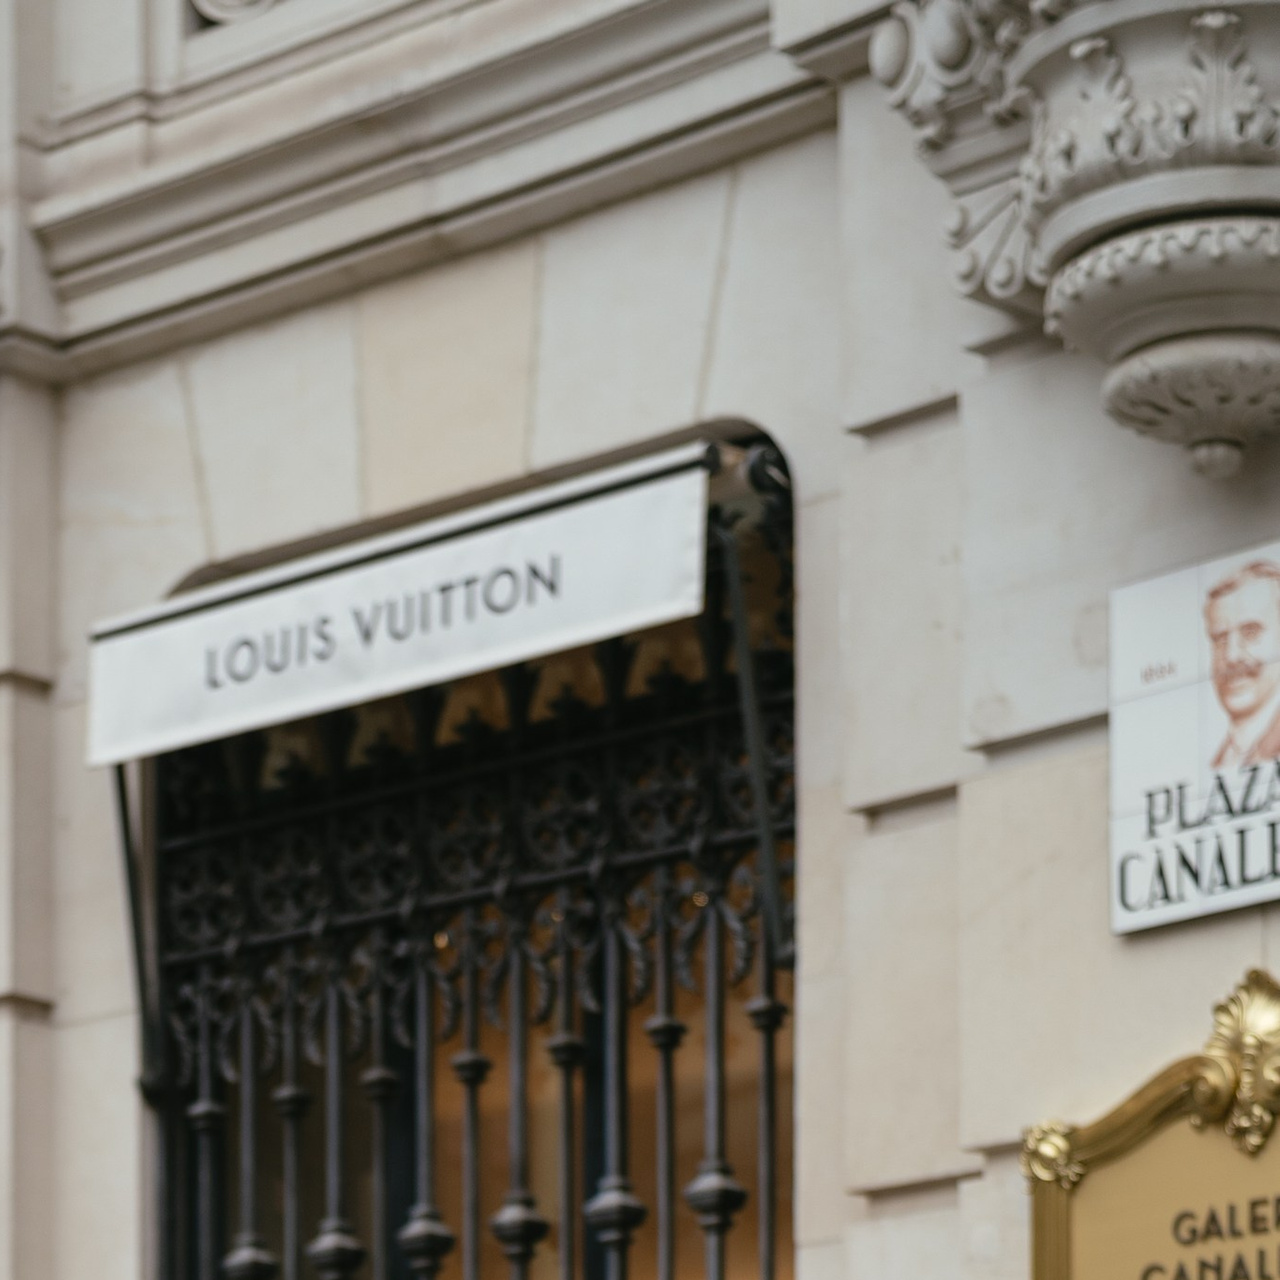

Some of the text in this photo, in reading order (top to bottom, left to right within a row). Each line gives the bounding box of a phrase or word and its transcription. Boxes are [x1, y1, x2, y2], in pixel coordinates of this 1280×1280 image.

[205, 553, 562, 690] LOUIS VUITTON
[1172, 1196, 1280, 1246] GALE
